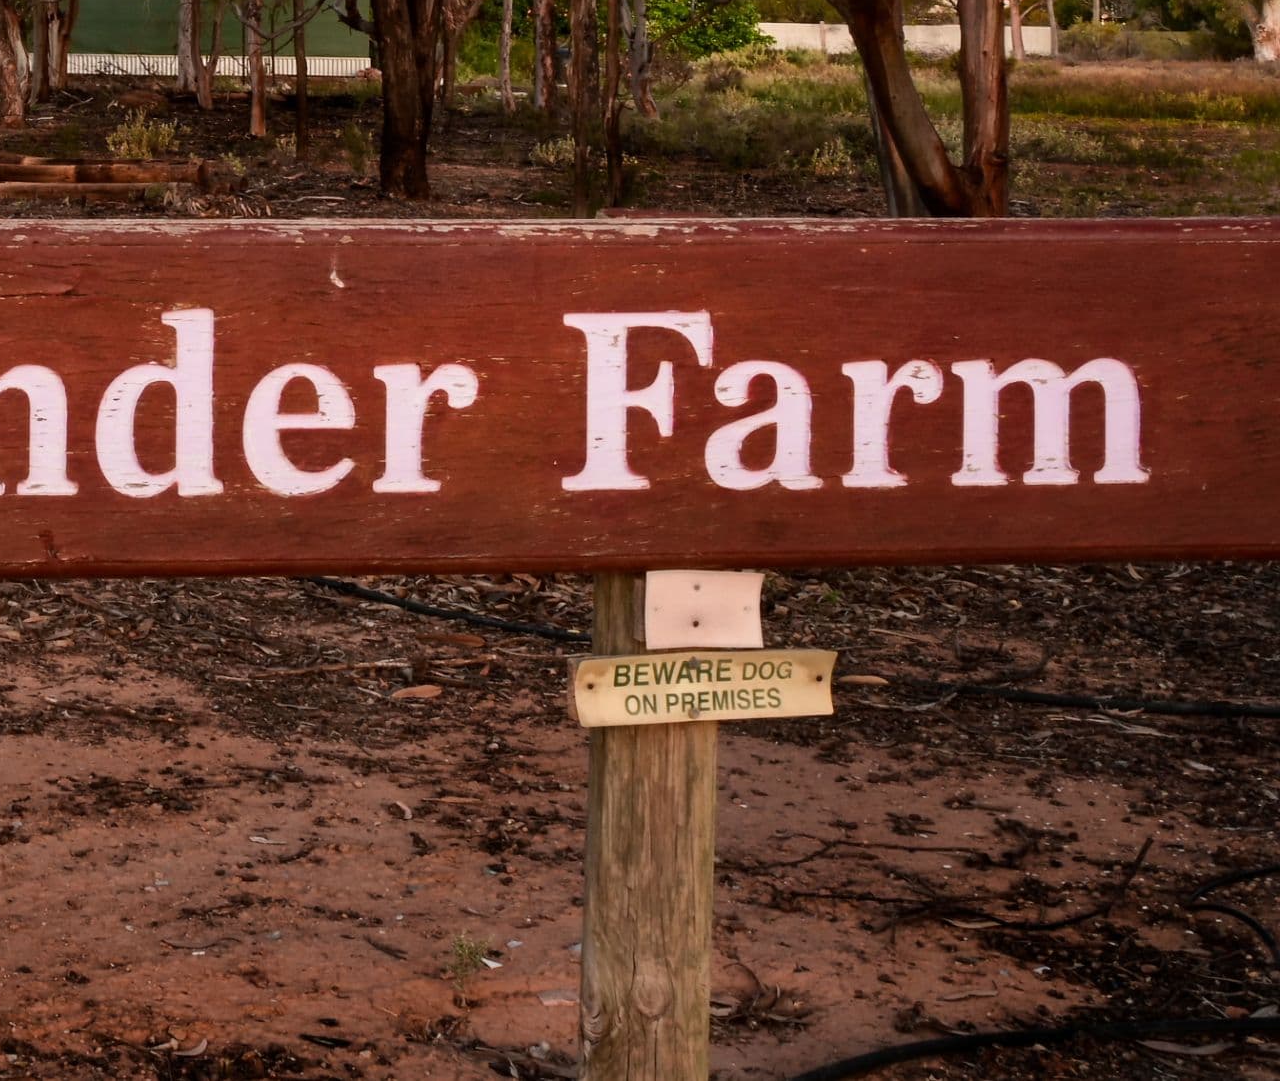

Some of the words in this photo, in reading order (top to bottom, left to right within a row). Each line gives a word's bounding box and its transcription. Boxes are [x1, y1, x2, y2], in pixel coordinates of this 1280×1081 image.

[561, 309, 1149, 492] Farm
[612, 658, 733, 688] BEWARE
[741, 661, 793, 681] DOG
[624, 694, 658, 716] ON
[665, 688, 782, 714] PREMISES
